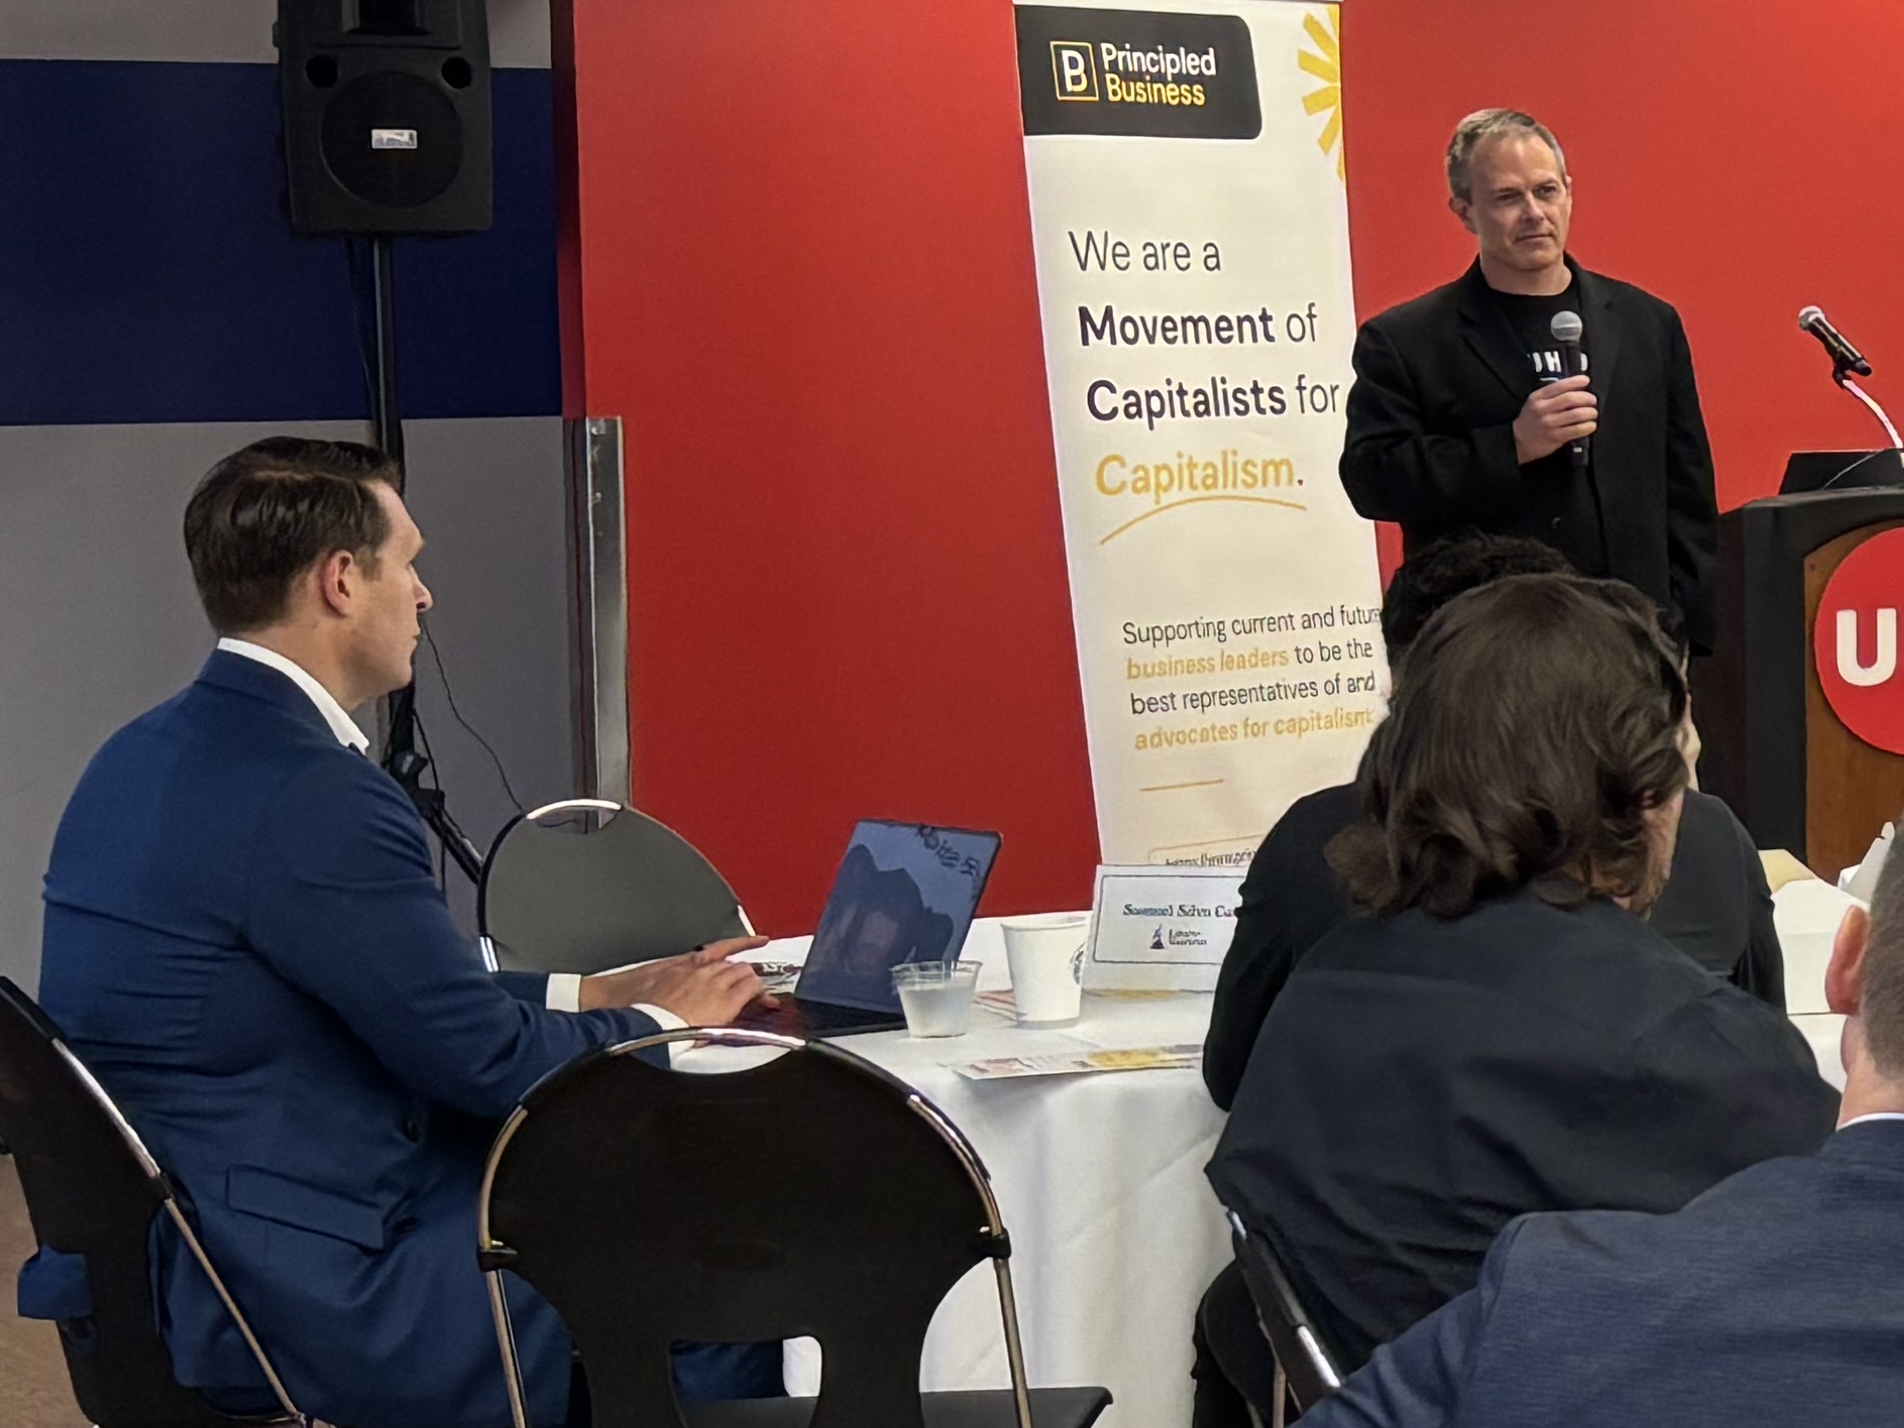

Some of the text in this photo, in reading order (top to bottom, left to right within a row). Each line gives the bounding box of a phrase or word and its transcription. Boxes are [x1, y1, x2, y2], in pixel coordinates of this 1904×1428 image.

[1101, 43, 1216, 81] Principled
[1106, 75, 1205, 106] Business
[1068, 231, 1222, 272] We are a
[1078, 303, 1317, 347] Movement of
[1087, 374, 1340, 431] Capitalists for
[1096, 448, 1303, 505] Capitalism.
[1123, 615, 1228, 647] Supporting
[1231, 612, 1296, 637] current
[1301, 606, 1336, 630] and
[1126, 638, 1374, 681] business leaders to be the
[1130, 669, 1376, 716] best representatives of and
[1134, 719, 1239, 751] advocates
[1242, 713, 1271, 739] for
